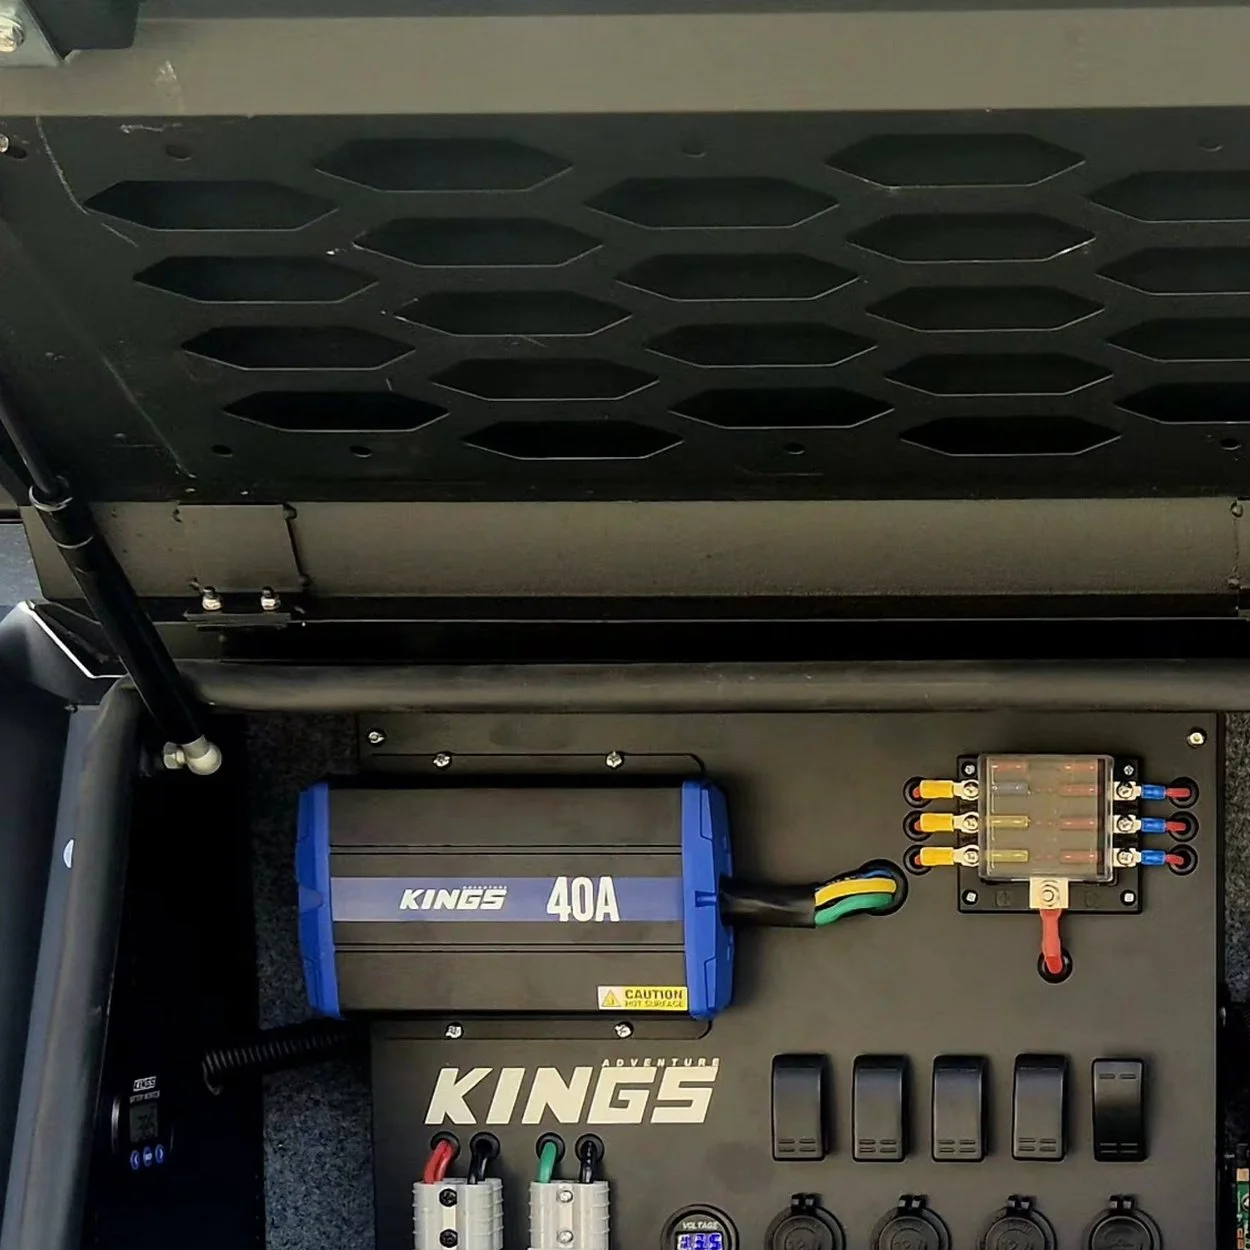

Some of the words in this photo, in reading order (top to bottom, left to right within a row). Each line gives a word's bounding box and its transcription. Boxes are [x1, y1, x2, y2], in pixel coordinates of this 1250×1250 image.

[400, 888, 508, 910] KINGS
[546, 876, 620, 922] 40A
[624, 989, 683, 1000] CAUTION
[601, 1057, 720, 1068] ADVENTURE
[425, 1066, 719, 1125] KINGS
[682, 1221, 718, 1230] VOLTAGE
